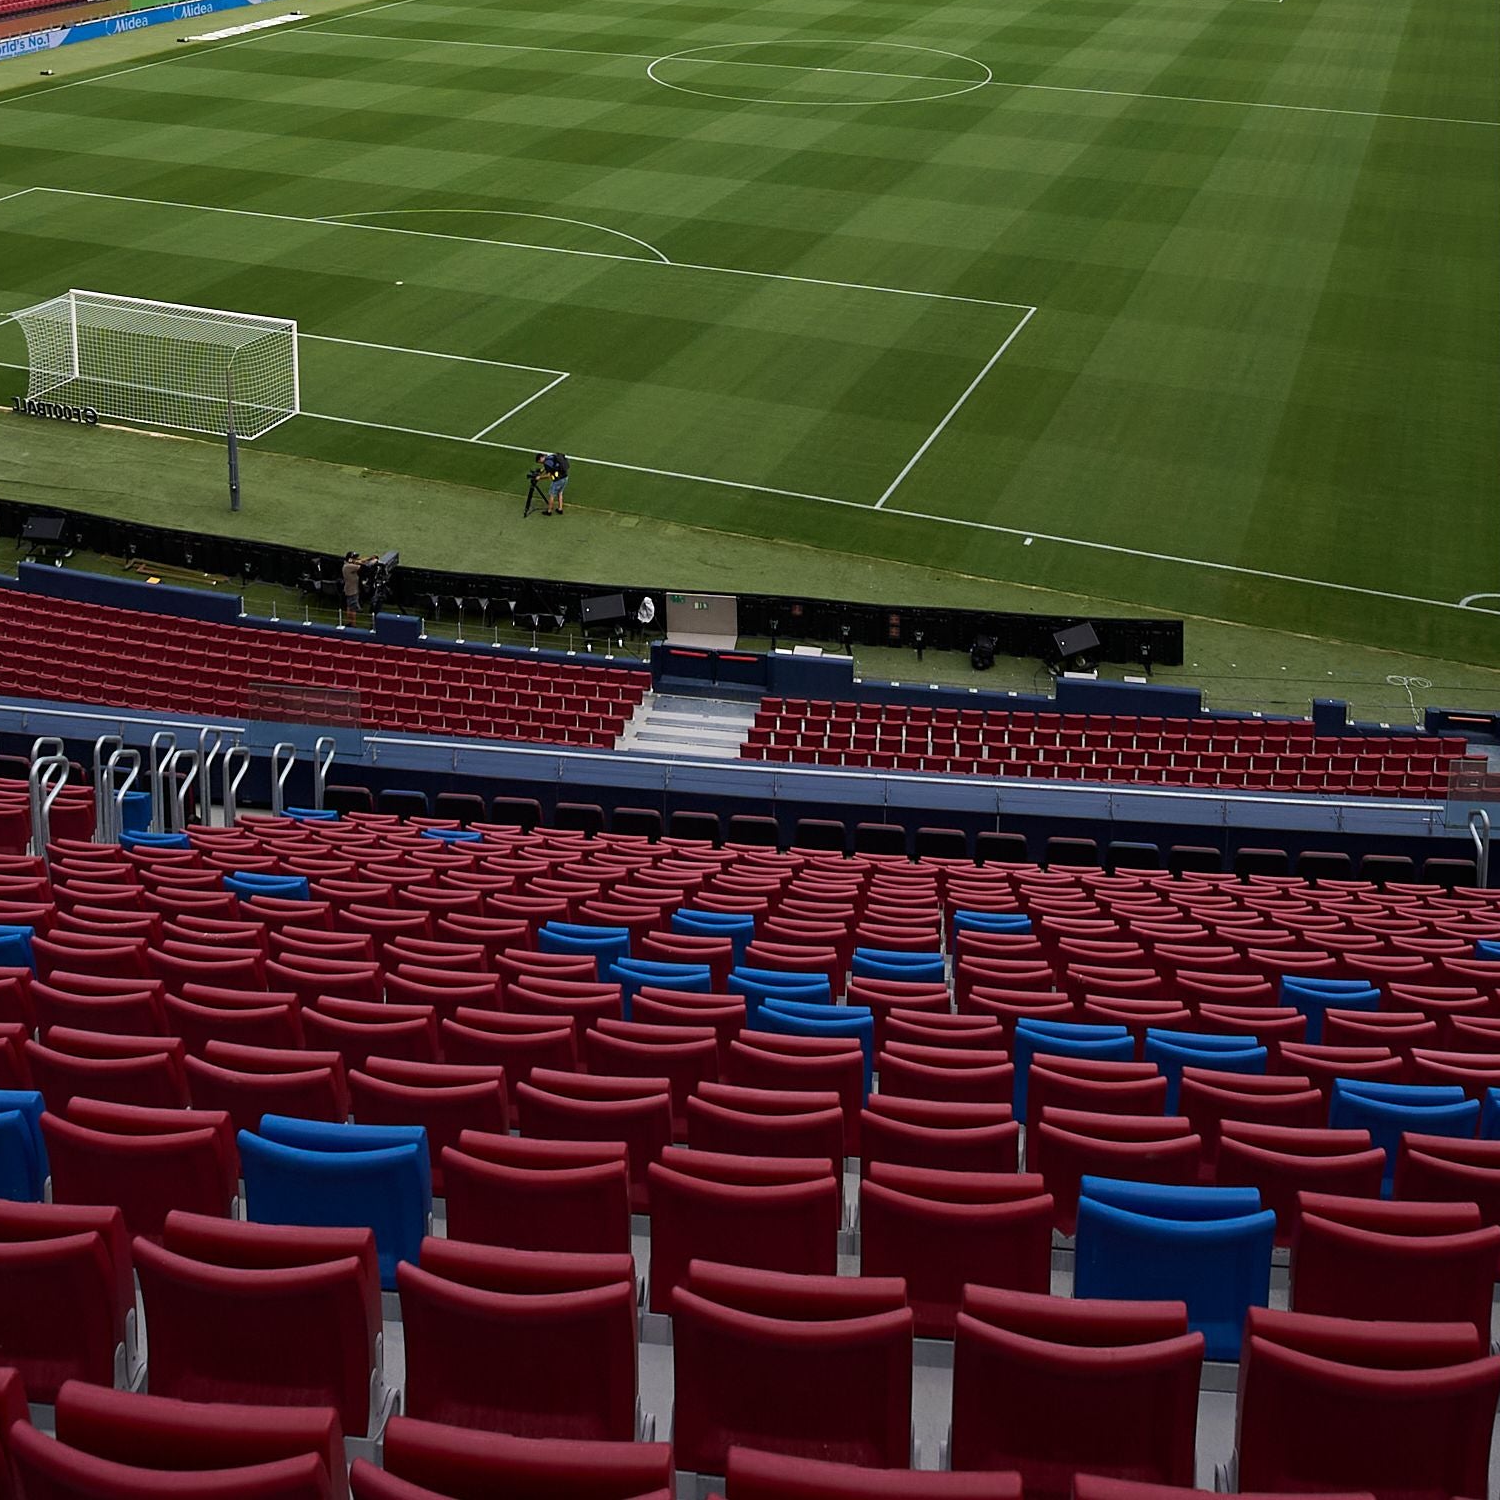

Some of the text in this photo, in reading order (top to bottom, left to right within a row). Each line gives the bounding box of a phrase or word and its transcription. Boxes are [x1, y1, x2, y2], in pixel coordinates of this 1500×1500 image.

[180, 2, 213, 20] Midea
[113, 14, 148, 34] Midea
[28, 33, 50, 47] No.1
